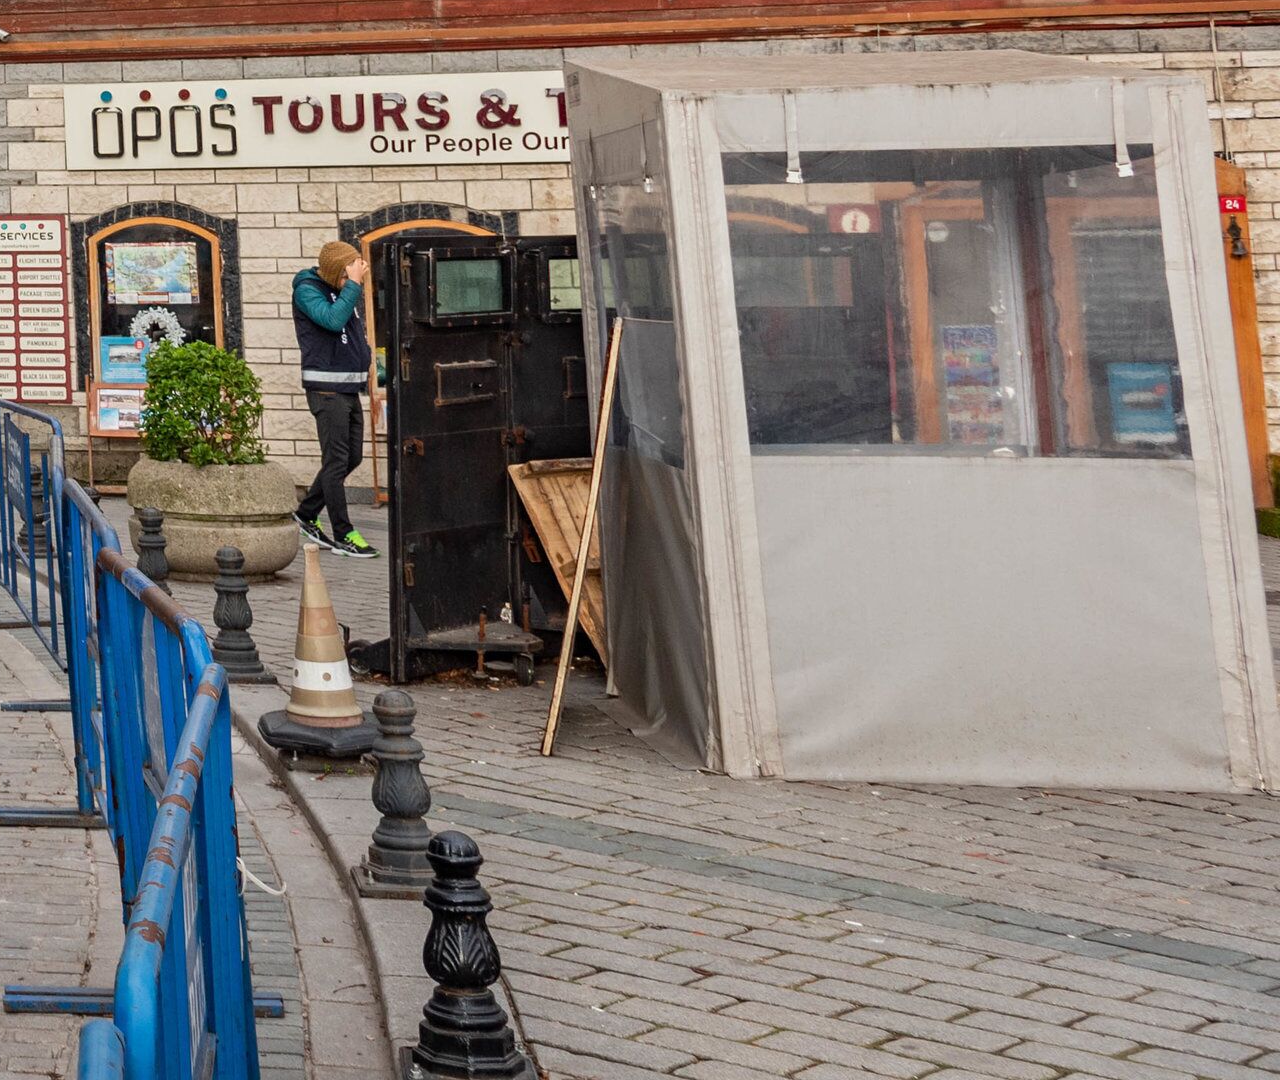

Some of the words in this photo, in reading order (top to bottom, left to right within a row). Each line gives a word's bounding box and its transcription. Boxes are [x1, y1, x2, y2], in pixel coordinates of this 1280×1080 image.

[252, 90, 450, 135] TOURS
[476, 88, 521, 129] &
[370, 134, 416, 154] Our
[425, 131, 513, 157] People
[522, 130, 570, 151] Our
[1225, 199, 1240, 210] 24
